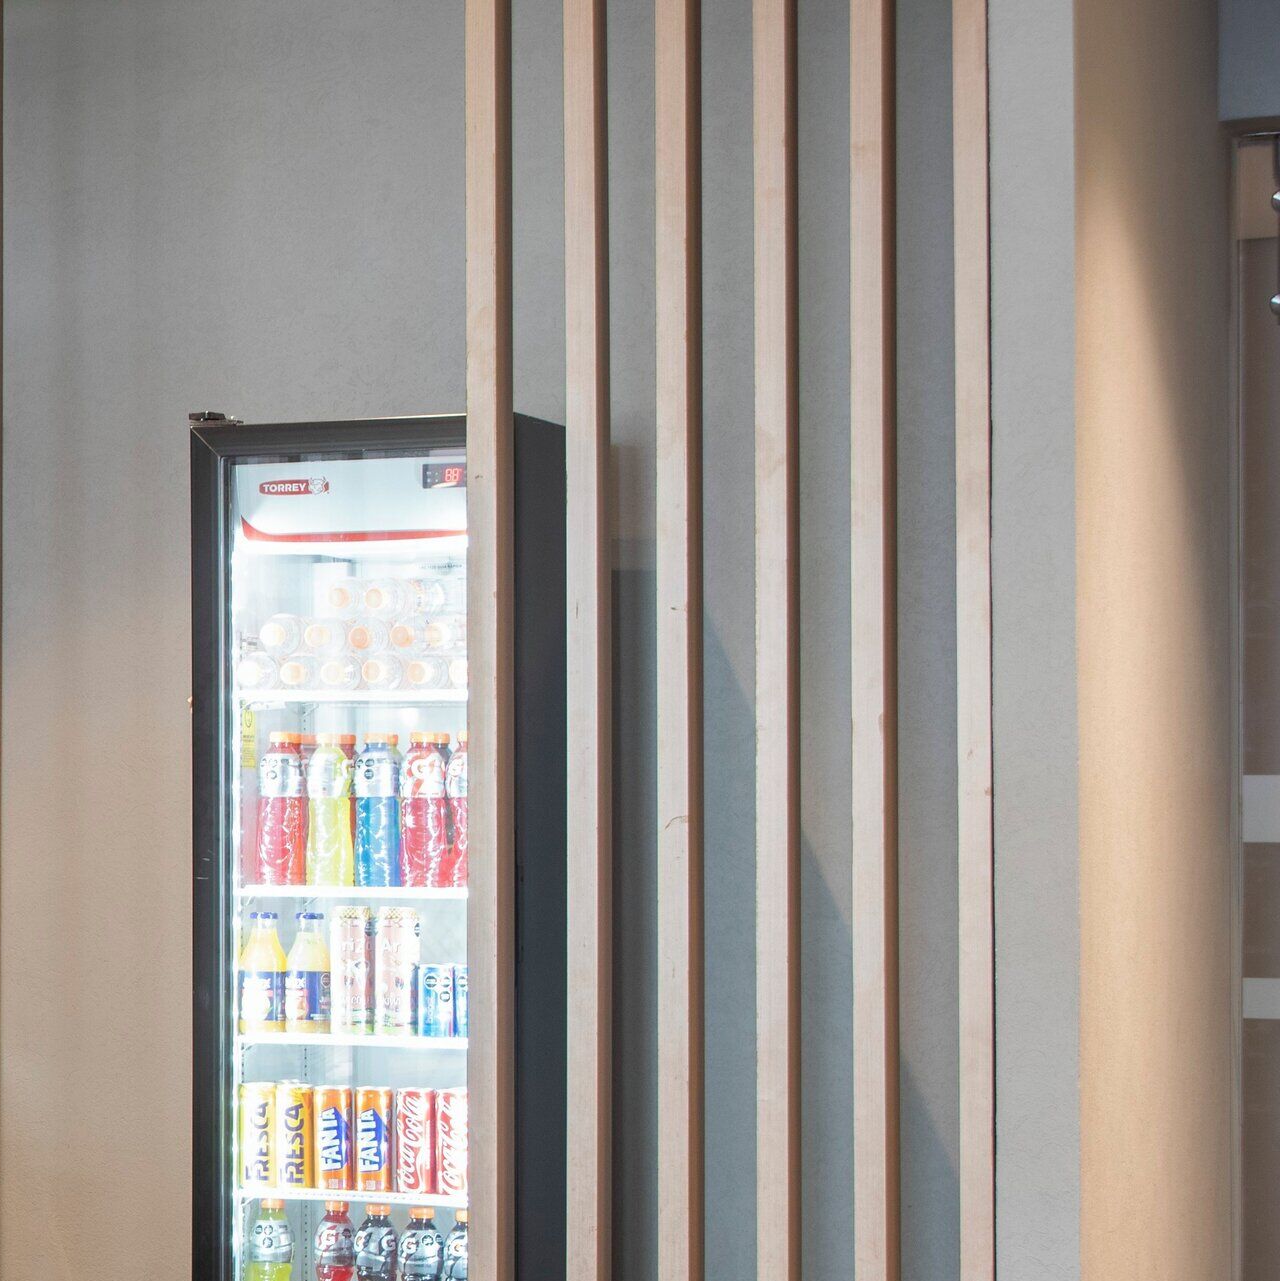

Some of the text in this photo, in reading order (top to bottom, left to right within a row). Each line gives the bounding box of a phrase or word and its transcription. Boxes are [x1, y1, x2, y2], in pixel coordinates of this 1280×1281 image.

[262, 482, 307, 493] TORREY
[280, 1103, 305, 1184] FRESCA
[320, 1107, 344, 1171] FANTA
[358, 1110, 380, 1173] FANTA
